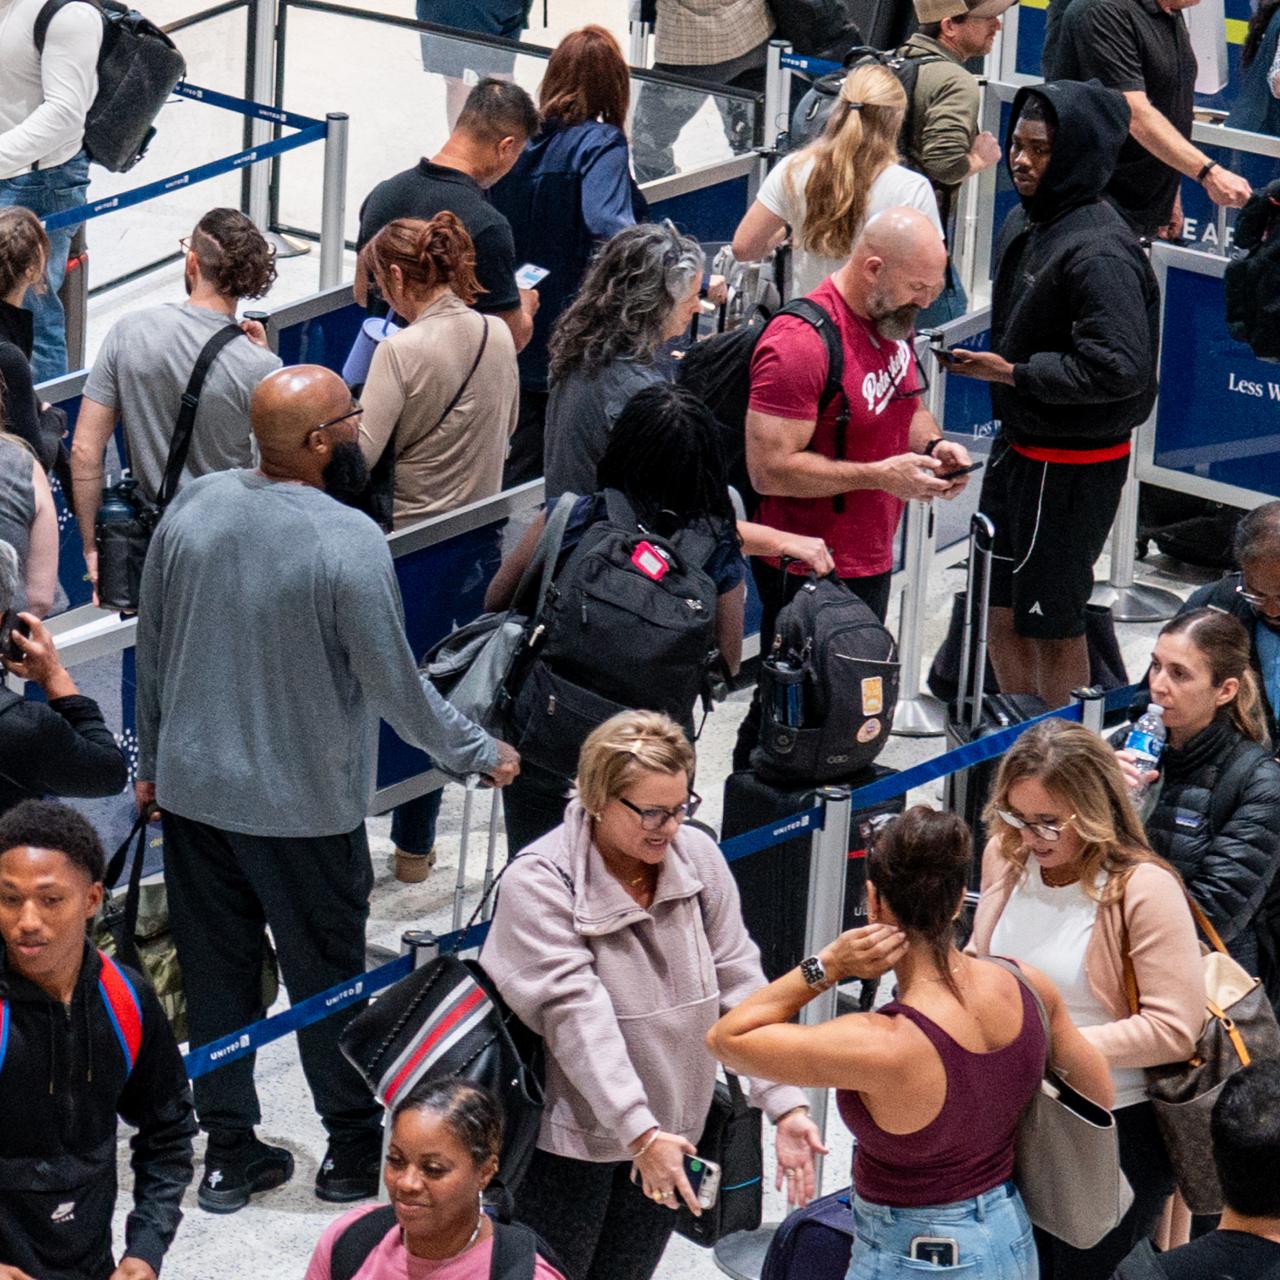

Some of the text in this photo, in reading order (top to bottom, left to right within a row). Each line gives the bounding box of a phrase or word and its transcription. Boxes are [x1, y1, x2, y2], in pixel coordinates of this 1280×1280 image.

[1229, 372, 1263, 397] Less
[773, 821, 801, 836] UNITED
[325, 989, 354, 1007] UNITED
[210, 1043, 239, 1060] UNITED
